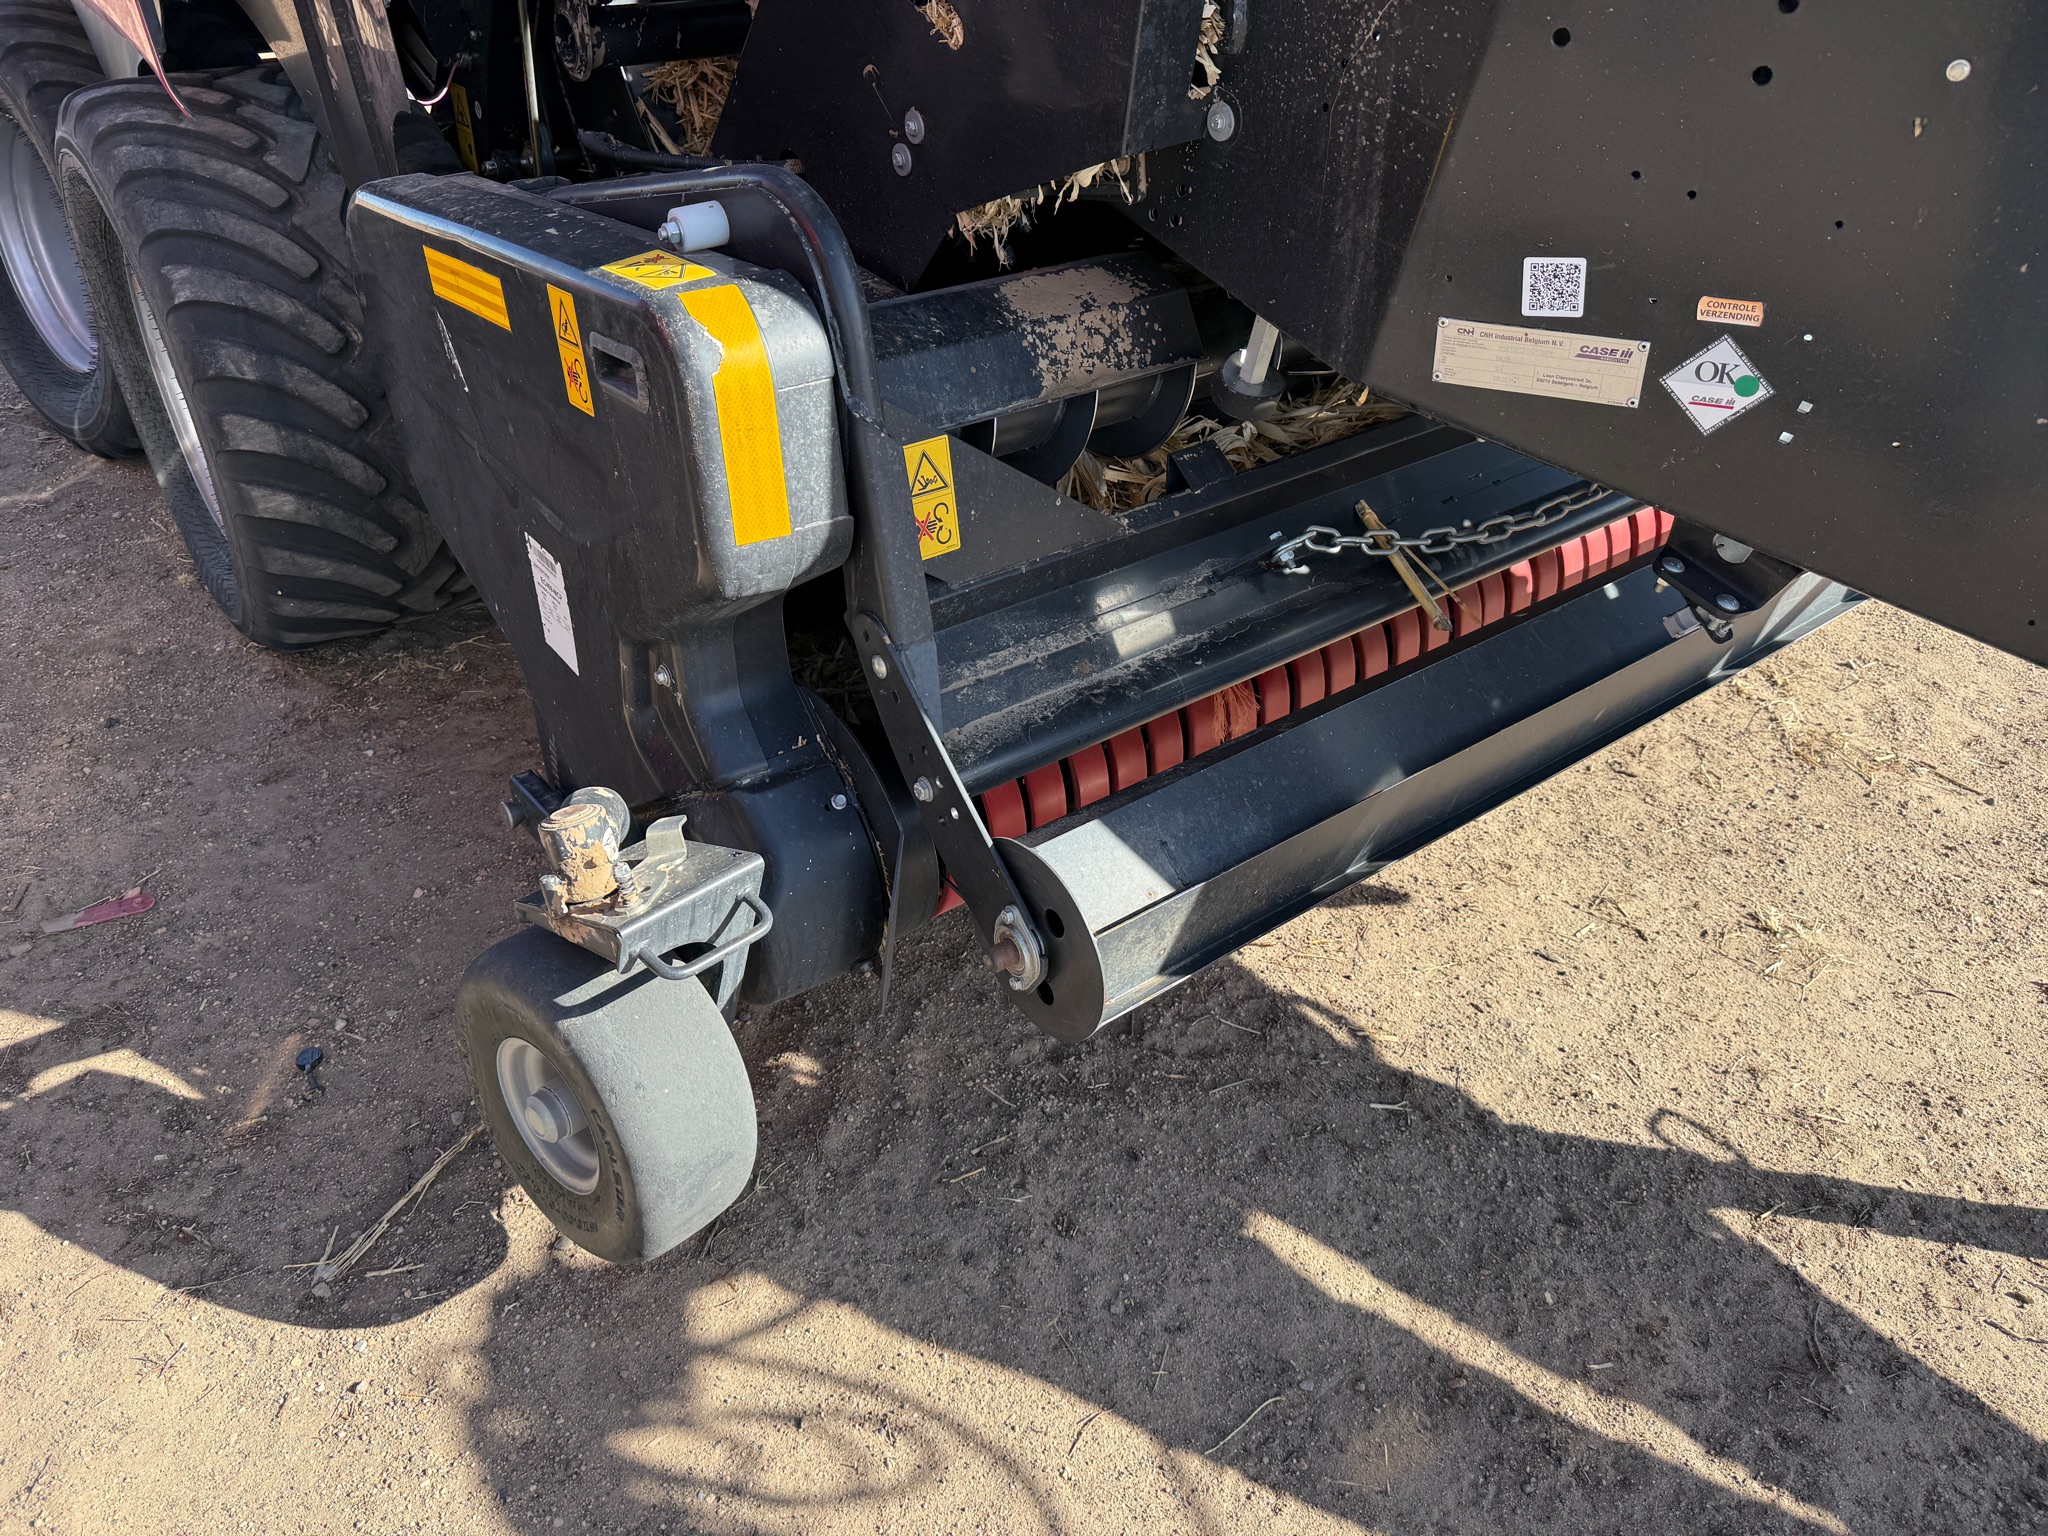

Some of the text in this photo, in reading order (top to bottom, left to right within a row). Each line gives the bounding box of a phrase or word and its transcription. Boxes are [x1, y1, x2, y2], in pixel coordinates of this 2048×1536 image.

[1707, 300, 1757, 312] CONTROLE
[1700, 309, 1760, 322] VERZENDING
[1479, 331, 1493, 339] CNH
[1494, 333, 1523, 342] Industrial
[1524, 336, 1550, 346] Belgium
[1551, 339, 1565, 347] N.V.
[1579, 345, 1620, 357] CASE
[1695, 360, 1740, 385] OK
[1691, 395, 1724, 405] CASE
[590, 1108, 626, 1223] CARLSTAR
